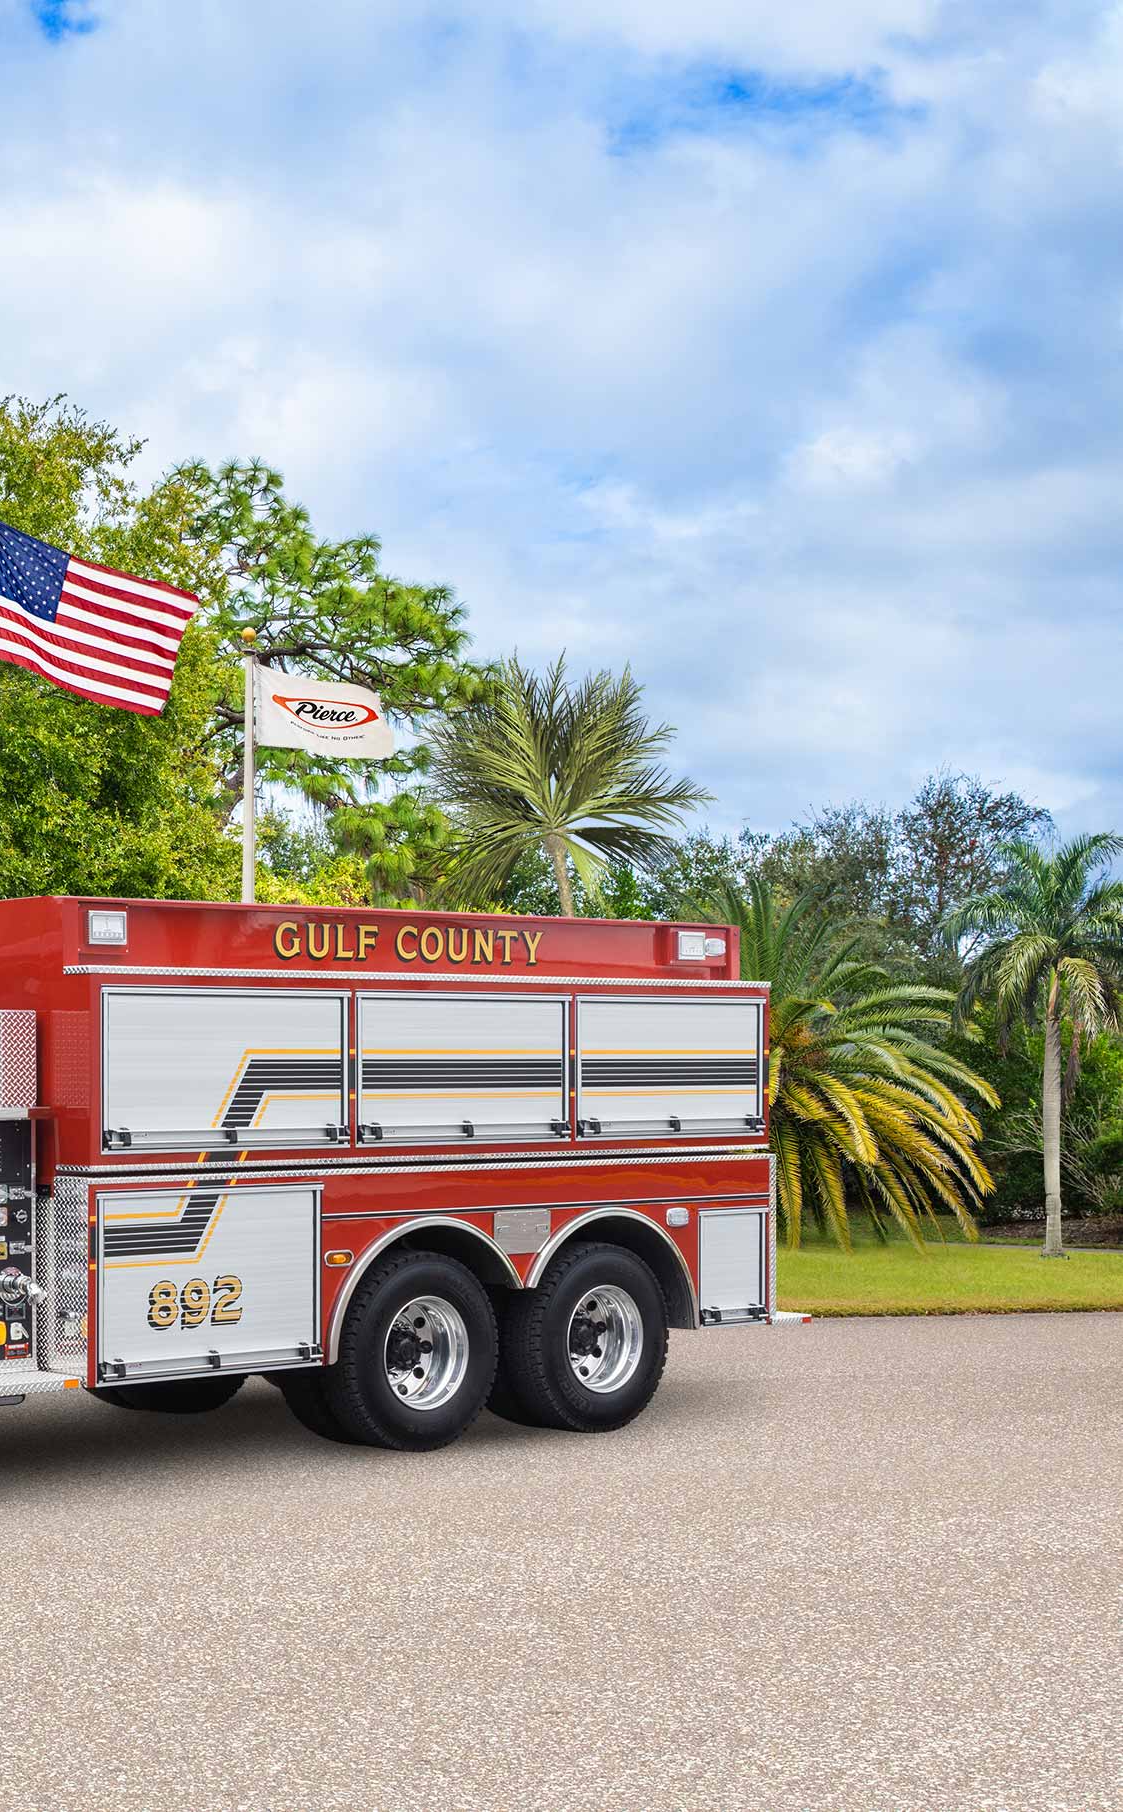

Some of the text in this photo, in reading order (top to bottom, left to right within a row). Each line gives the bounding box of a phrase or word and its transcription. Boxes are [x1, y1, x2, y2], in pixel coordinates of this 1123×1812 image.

[295, 701, 357, 722] Pierce
[273, 921, 544, 966] GULF COUNTY
[147, 1274, 243, 1331] 892
